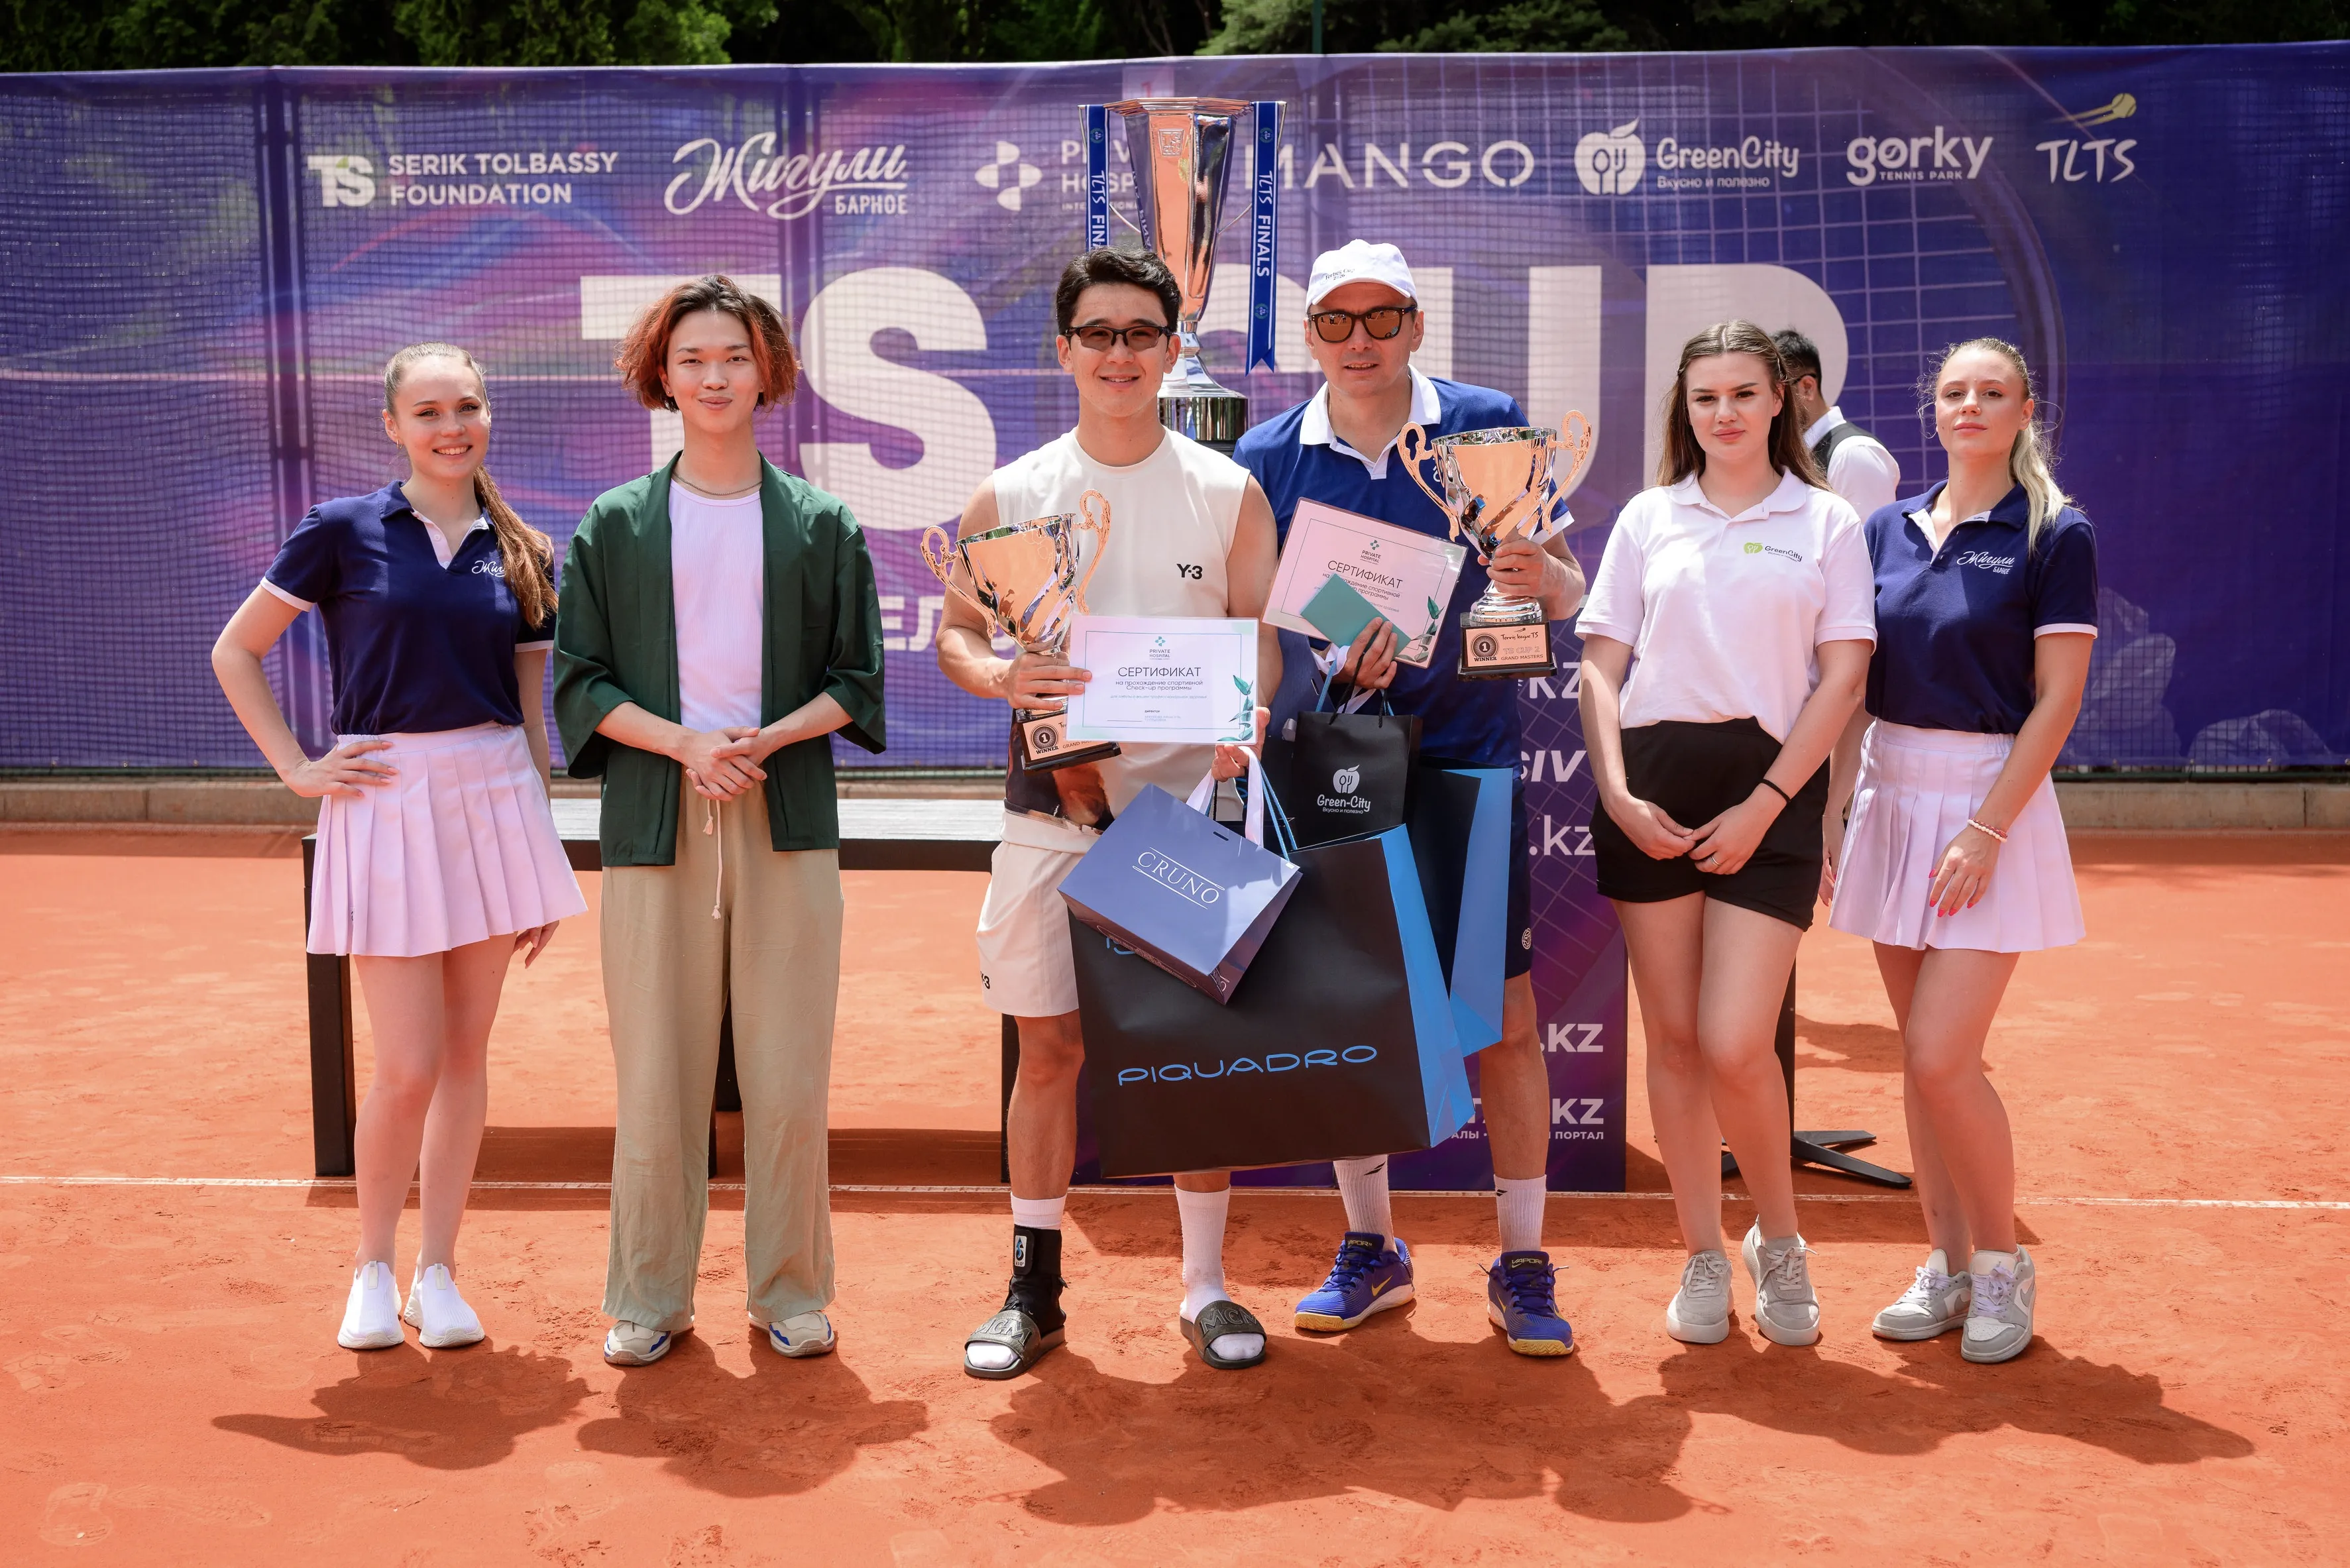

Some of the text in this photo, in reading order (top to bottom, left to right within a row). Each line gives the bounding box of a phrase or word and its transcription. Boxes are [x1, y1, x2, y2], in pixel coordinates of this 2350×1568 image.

[388, 151, 619, 176] SERIK TOLBASSY
[1245, 139, 1535, 190] MANGO
[1657, 135, 1800, 178] GreenCity
[1846, 125, 1993, 186] gorky
[2035, 139, 2138, 184] TLTS
[307, 154, 376, 207] TS
[664, 131, 909, 220] Жигули
[1657, 176, 1770, 191] Вкусно и полезно
[1879, 170, 1962, 181] TENNIS PARK
[390, 182, 573, 205] FOUNDATION
[1091, 170, 1105, 204] TLTS
[835, 194, 909, 215] БАРНОЕ
[1257, 170, 1272, 277] TLTS FINALS
[1362, 550, 1381, 559] PRIVATE
[1765, 545, 1803, 562] GreenCity
[1956, 551, 2015, 569] Жигули
[471, 560, 506, 577] Жиг
[1176, 563, 1203, 580] Y-3
[1327, 560, 1403, 588] СЕРТИФИКАТ
[1992, 566, 2011, 575] БАРНОЕ
[1342, 579, 1368, 589] ождение
[1368, 585, 1400, 598] спортивной
[1359, 588, 1389, 600] программы
[1482, 642, 1488, 651] 1
[1118, 667, 1202, 677] СЕРТИФИКАТ
[1041, 734, 1048, 742] 1
[1035, 746, 1059, 755] WINNER
[1317, 794, 1371, 812] Green-City
[1137, 850, 1220, 905] CRUNO
[1117, 1044, 1377, 1086] PIQUADRO
[1451, 1130, 1604, 1140] АЛЫ ПОРТАЛ
